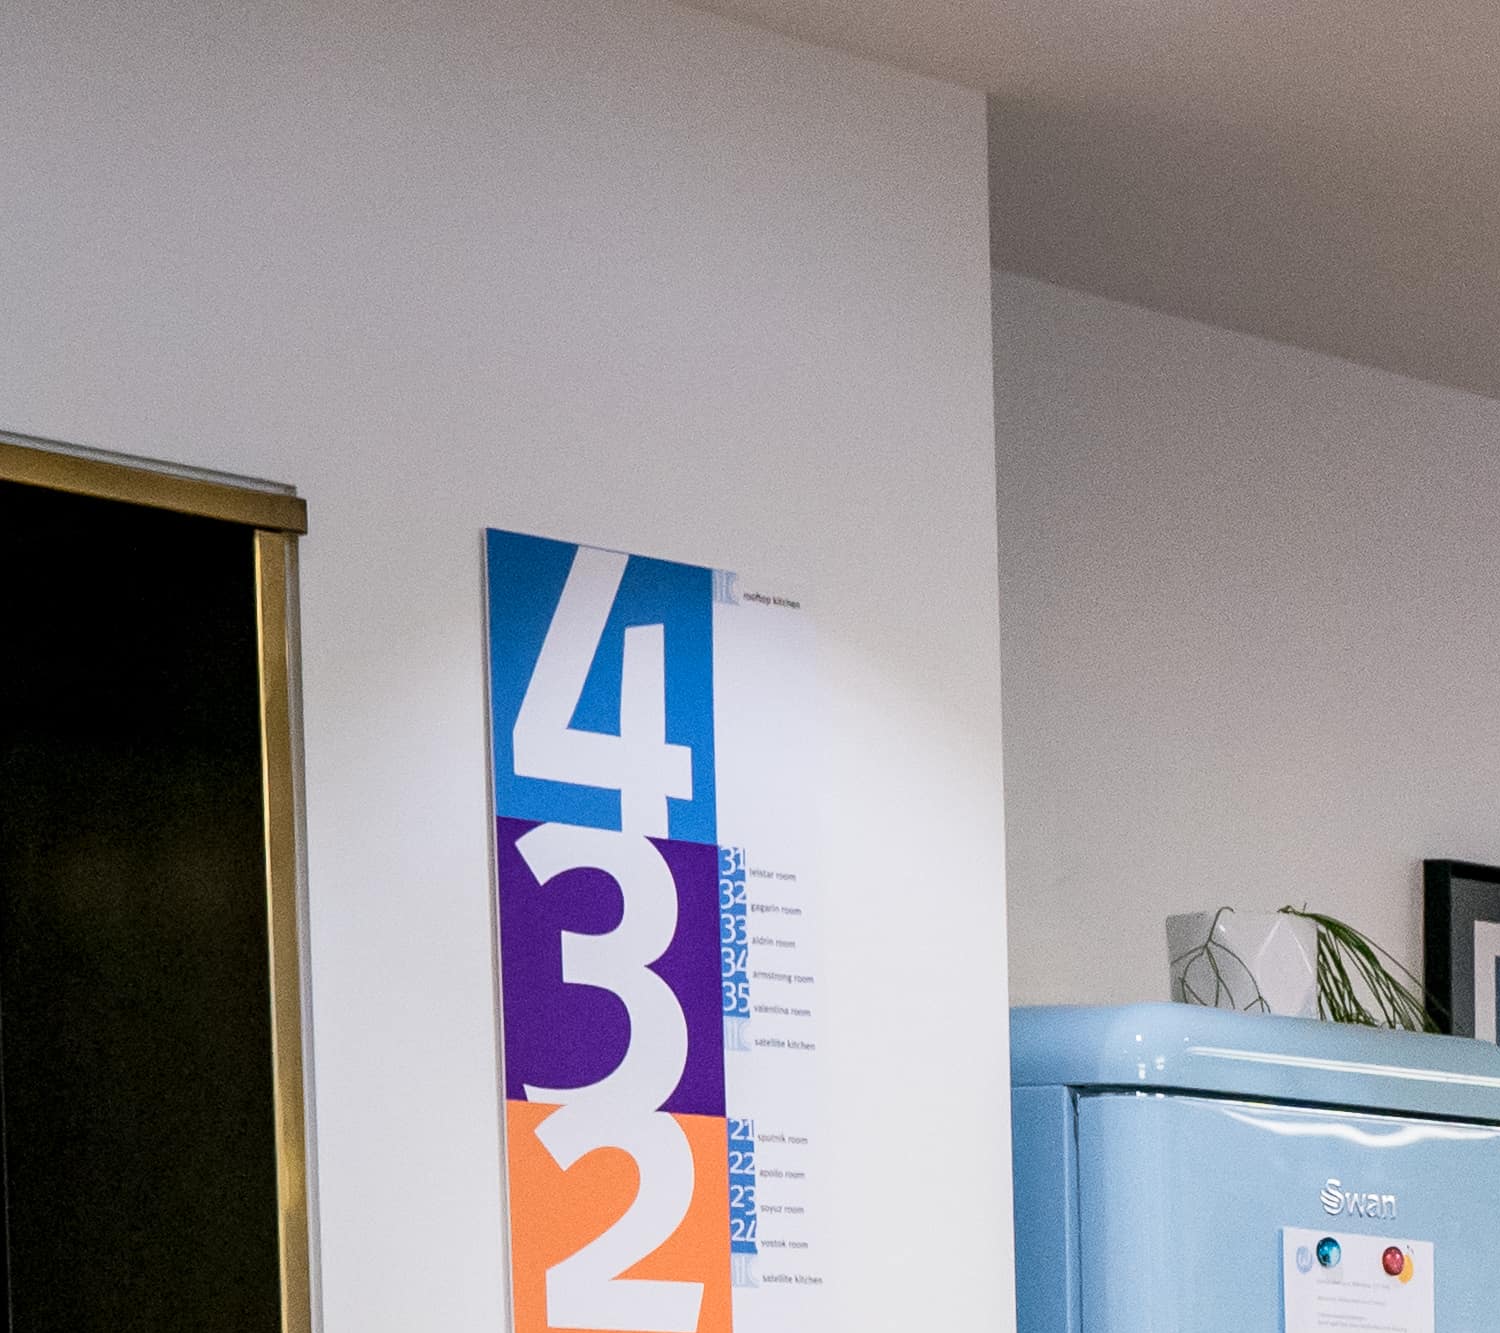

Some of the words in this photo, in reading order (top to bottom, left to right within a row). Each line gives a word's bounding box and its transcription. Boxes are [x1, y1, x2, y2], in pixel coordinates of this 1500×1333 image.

[513, 545, 693, 838] 4
[720, 847, 745, 876] 31
[720, 879, 746, 909] 32
[721, 913, 748, 944] 33
[515, 822, 688, 1105] 3
[794, 975, 814, 984] room
[722, 981, 749, 1013] 35
[787, 1039, 816, 1050] kitchen
[729, 1119, 755, 1141] 21
[788, 1136, 808, 1144] room
[729, 1151, 755, 1175] 22
[730, 1184, 756, 1216] 23
[1320, 1178, 1398, 1220] Swan
[534, 1104, 704, 1333] 2
[788, 1241, 808, 1249] room
[794, 1275, 823, 1285] kitchen
